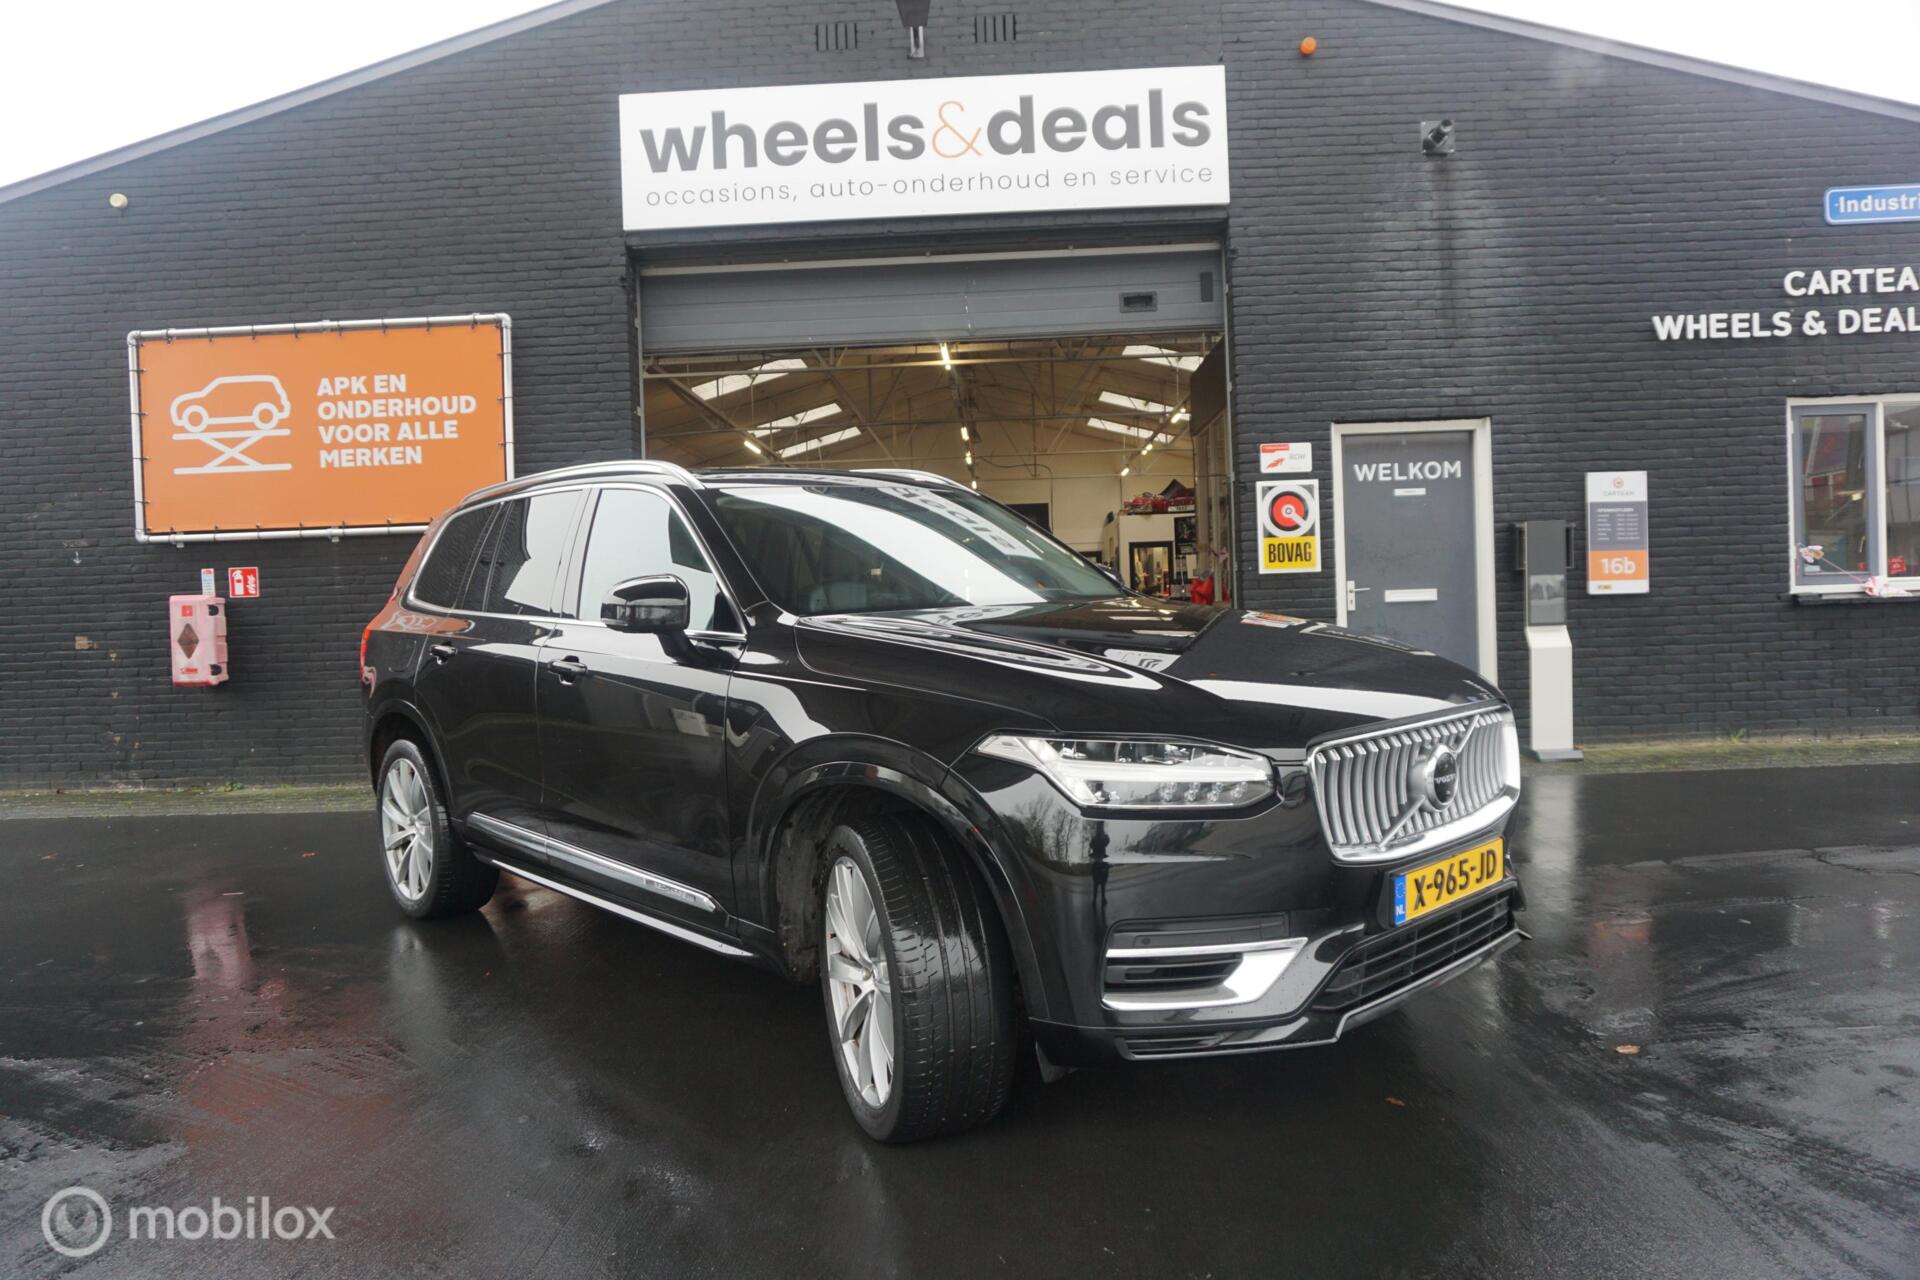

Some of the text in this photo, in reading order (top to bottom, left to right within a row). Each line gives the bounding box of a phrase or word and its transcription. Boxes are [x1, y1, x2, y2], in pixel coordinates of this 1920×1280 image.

[639, 88, 1212, 173] wheels&deals
[646, 163, 1213, 207] occasions, auto-onderhoud en service
[1783, 266, 1920, 297] CARTEA
[1652, 307, 1920, 341] WHEELS & DEAL
[317, 374, 407, 396] APK EN
[318, 395, 477, 420] ONDERHOUD
[318, 420, 459, 445] VOOR ALLE
[319, 446, 423, 469] MERKEN
[1353, 460, 1462, 481] WELKOM
[1268, 541, 1313, 564] BOVAG
[1601, 557, 1637, 575] 16b
[1413, 849, 1498, 911] X-965-JD
[1395, 904, 1405, 916] NL
